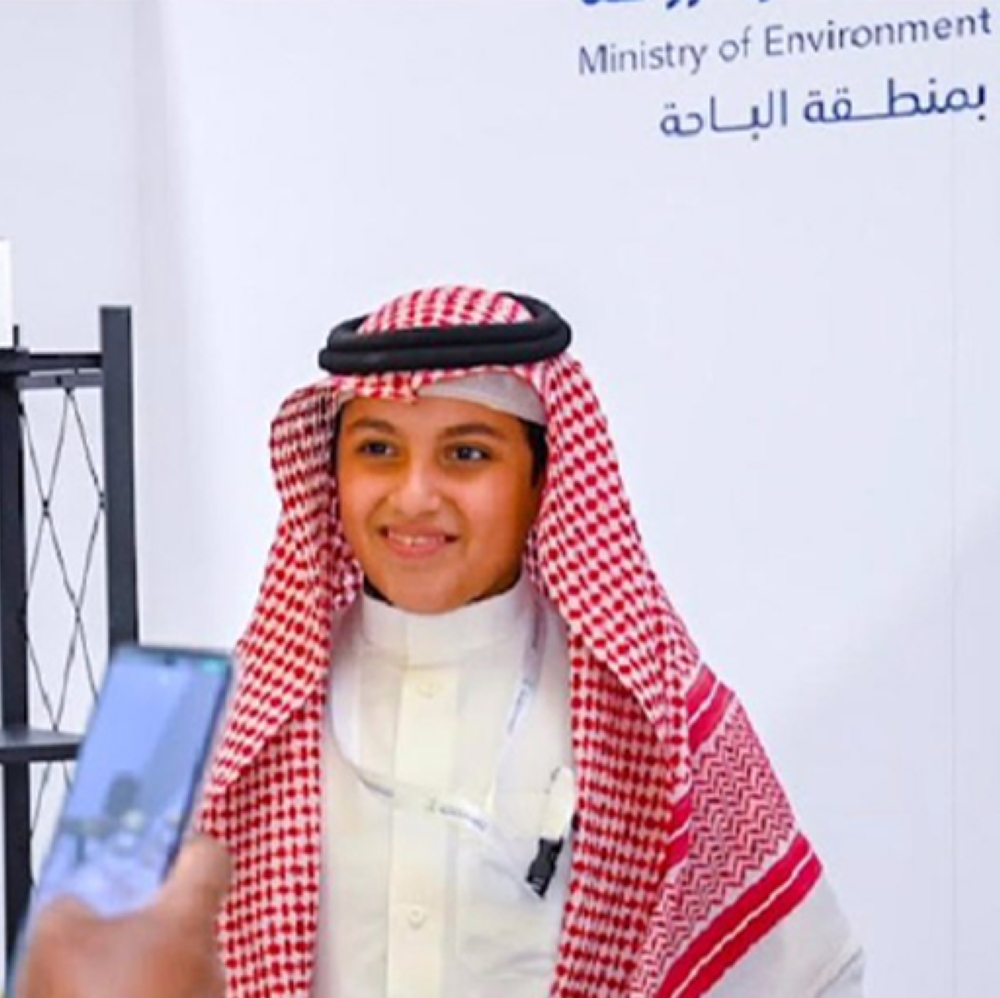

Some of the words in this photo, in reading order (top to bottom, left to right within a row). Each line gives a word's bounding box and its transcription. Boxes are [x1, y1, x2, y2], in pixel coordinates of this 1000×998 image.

[578, 41, 707, 76] Ministry
[718, 26, 753, 63] of
[764, 8, 992, 57] Environment
